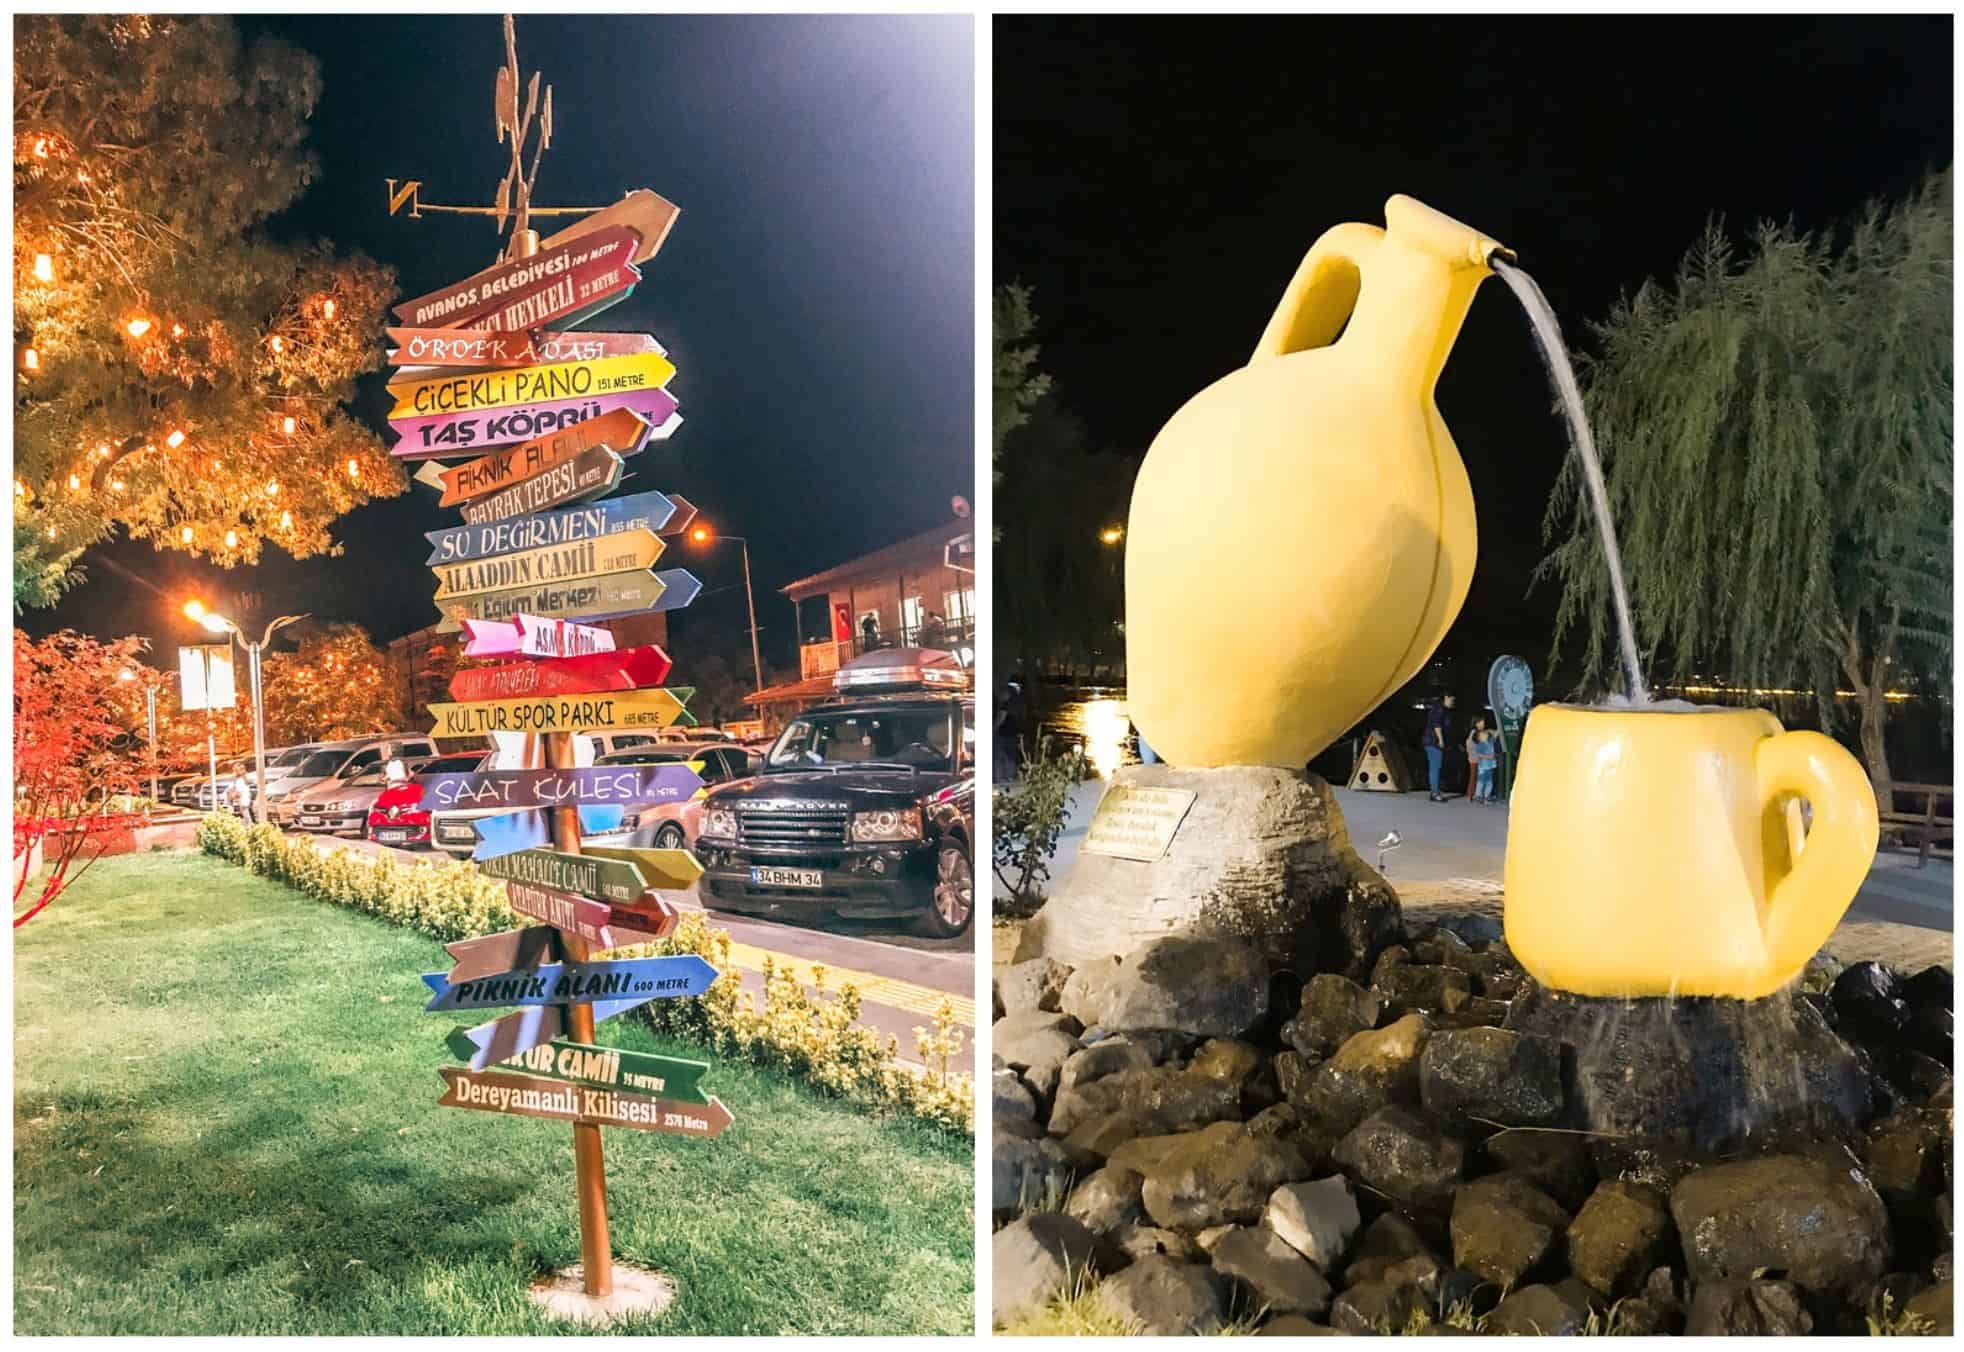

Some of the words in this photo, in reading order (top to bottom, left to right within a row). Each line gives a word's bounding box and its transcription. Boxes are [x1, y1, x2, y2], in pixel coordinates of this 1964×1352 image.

[416, 288, 478, 325] AVANOS
[408, 336, 508, 360] ÖRDEK
[516, 366, 592, 402] PANO
[613, 374, 645, 388] METRE
[417, 419, 480, 447] TAŞ
[487, 401, 601, 440] KÖPRÜ
[440, 531, 471, 560] SU
[447, 704, 508, 734] KÜLTÜR
[513, 701, 557, 730] SPOR
[561, 700, 615, 726] PARKI
[434, 780, 518, 804] SAAT
[773, 871, 802, 884] BHM
[805, 873, 821, 886] 34
[554, 972, 633, 997] ALANI
[633, 982, 653, 992] 600
[655, 978, 690, 990] METRE
[456, 1076, 580, 1115] Dereyamanlı
[583, 1086, 657, 1124] Kilisesi
